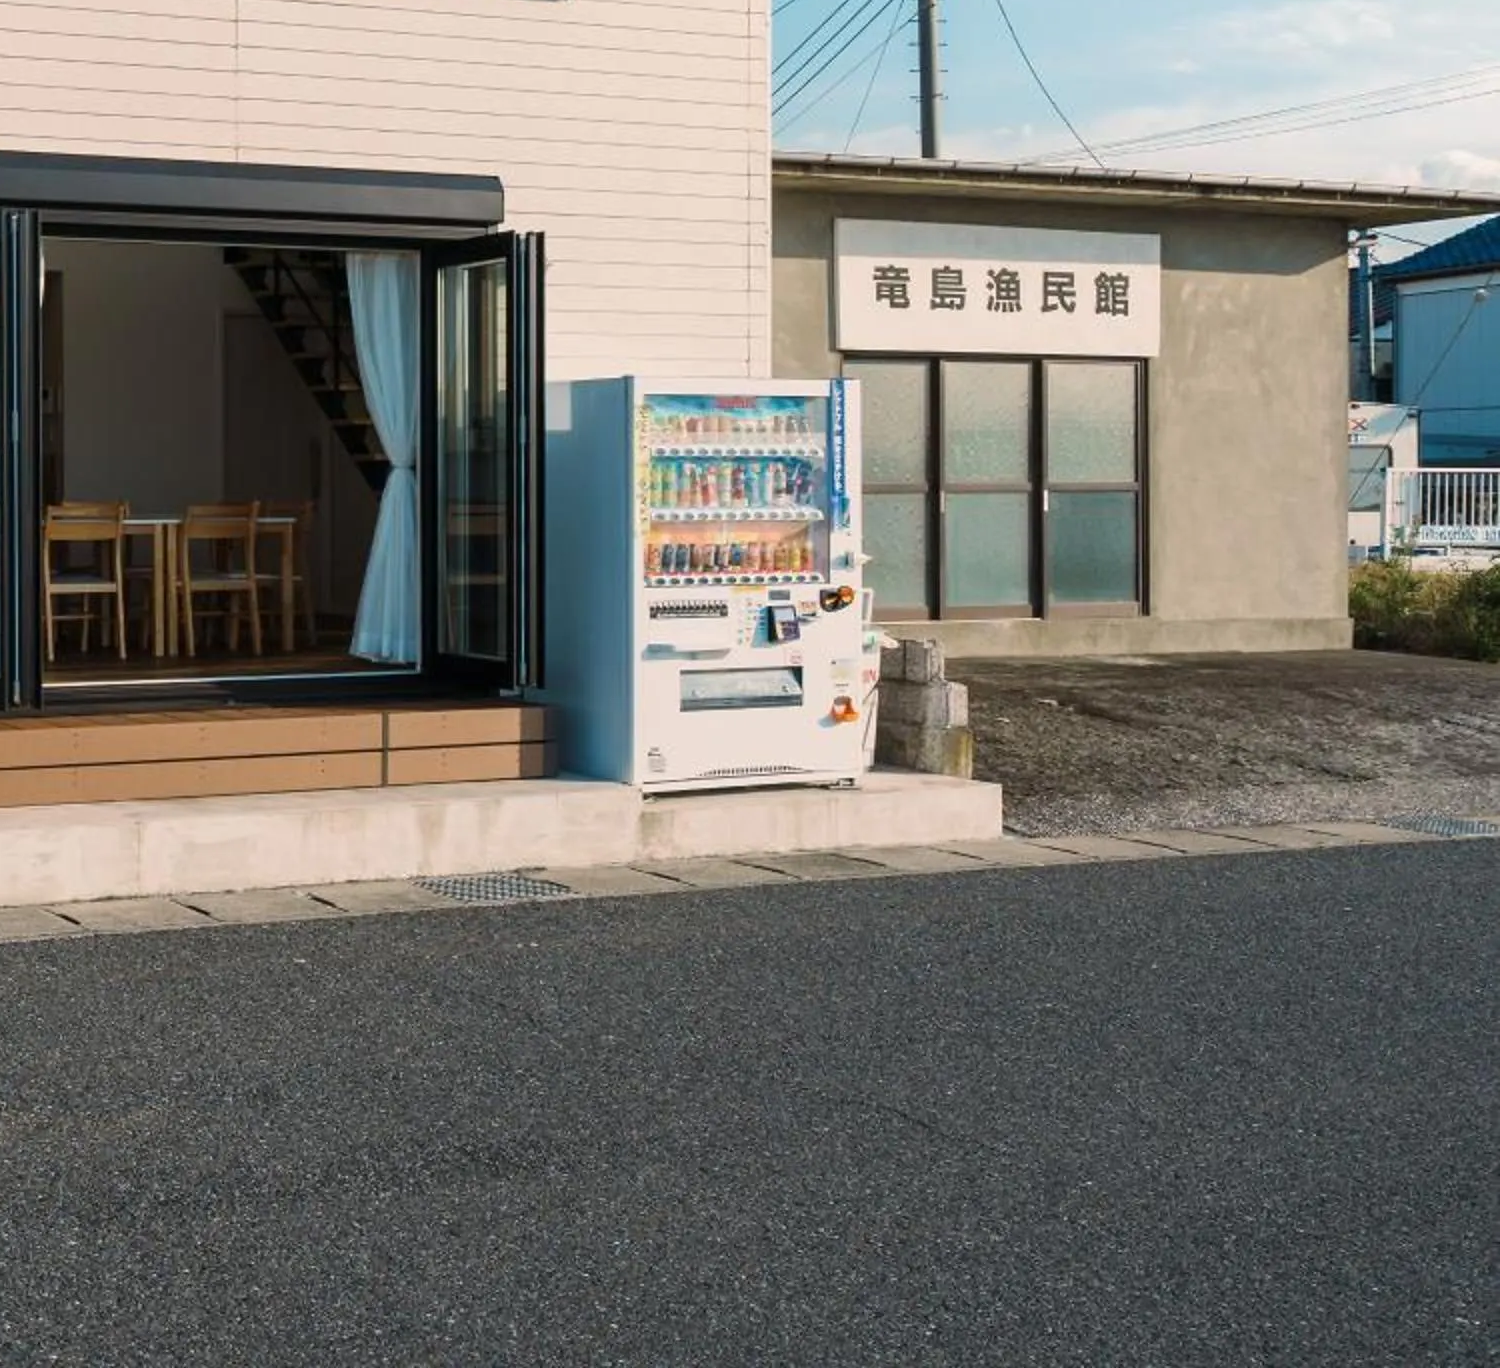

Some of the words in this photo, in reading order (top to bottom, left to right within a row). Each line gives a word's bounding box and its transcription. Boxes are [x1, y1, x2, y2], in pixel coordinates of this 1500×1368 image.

[872, 264, 1130, 317] 竜島漁民館
